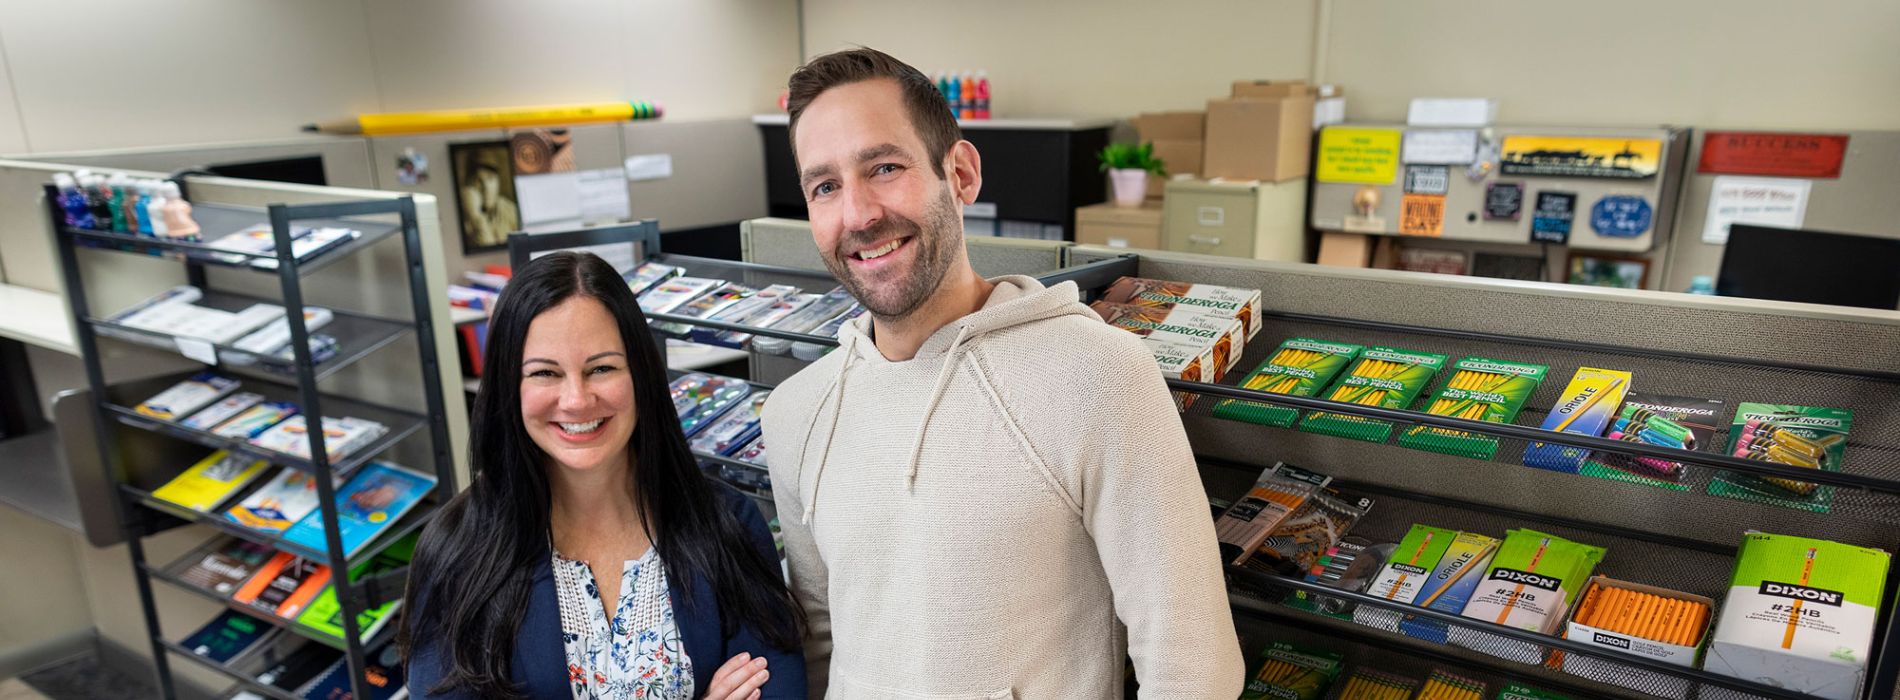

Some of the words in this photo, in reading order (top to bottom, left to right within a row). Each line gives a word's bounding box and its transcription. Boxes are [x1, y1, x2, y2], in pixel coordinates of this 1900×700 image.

[1139, 291, 1240, 311] TICONDEROGA
[1116, 318, 1218, 339] TICONDEROGA
[1284, 369, 1316, 379] PENCIL
[1369, 380, 1403, 391] PENCIL
[1469, 393, 1505, 404] PENCIL
[1560, 386, 1597, 414] ORIOLE
[1625, 401, 1714, 416] TICONDEROGA
[1358, 498, 1370, 507] 8
[1394, 563, 1425, 574] DIXON
[1437, 551, 1474, 580] ORIOLE
[1495, 569, 1555, 588] DIXON
[1495, 588, 1536, 601] #2HB
[1766, 583, 1838, 603] DIXON
[1770, 603, 1821, 618] #2HB
[1595, 634, 1629, 648] DIXON
